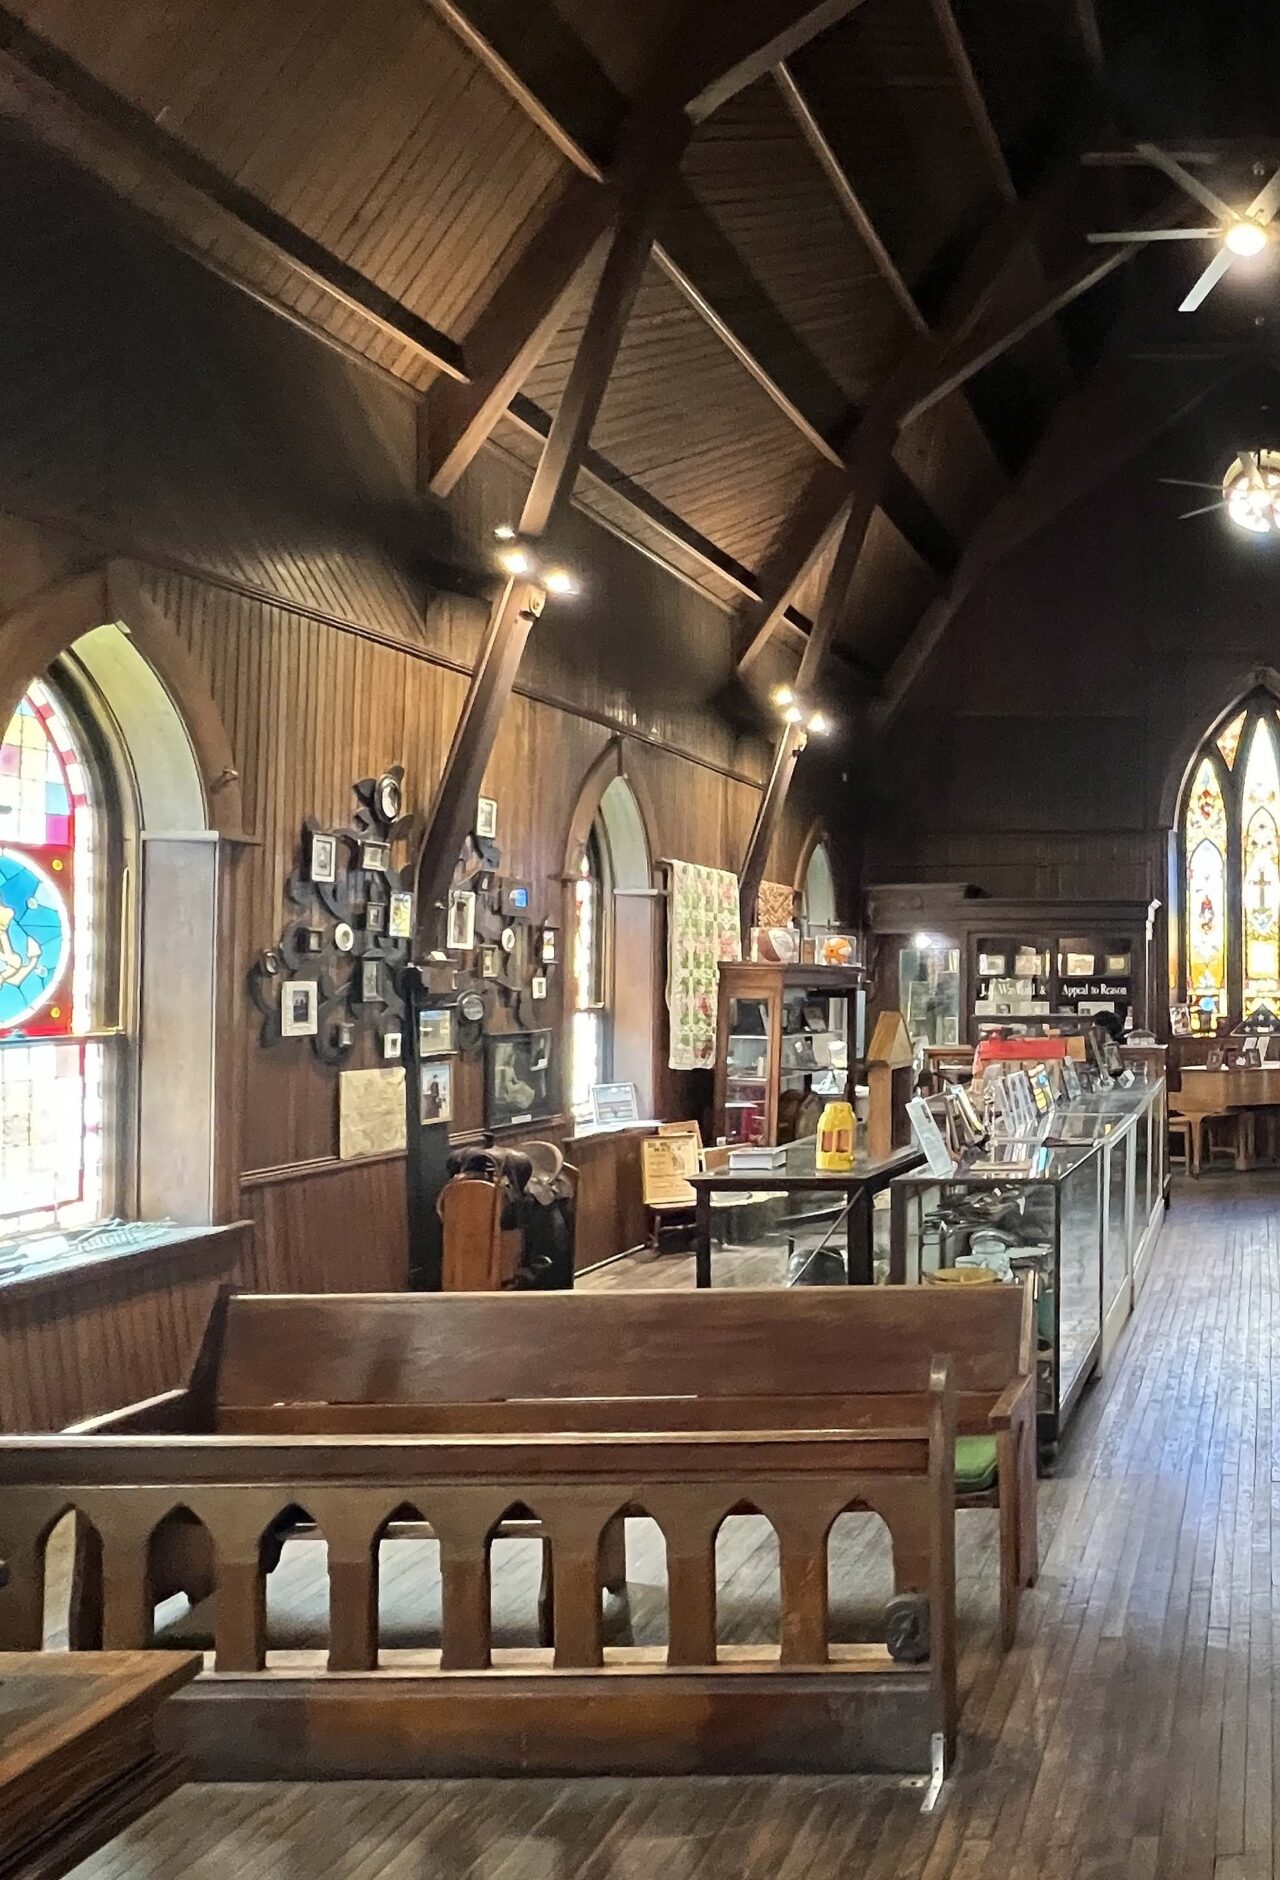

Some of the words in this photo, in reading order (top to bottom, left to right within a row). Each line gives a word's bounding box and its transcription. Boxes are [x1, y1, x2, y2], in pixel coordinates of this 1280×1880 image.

[1062, 983, 1089, 998] Appeal
[1090, 985, 1100, 995] to
[1100, 983, 1128, 995] Reason
